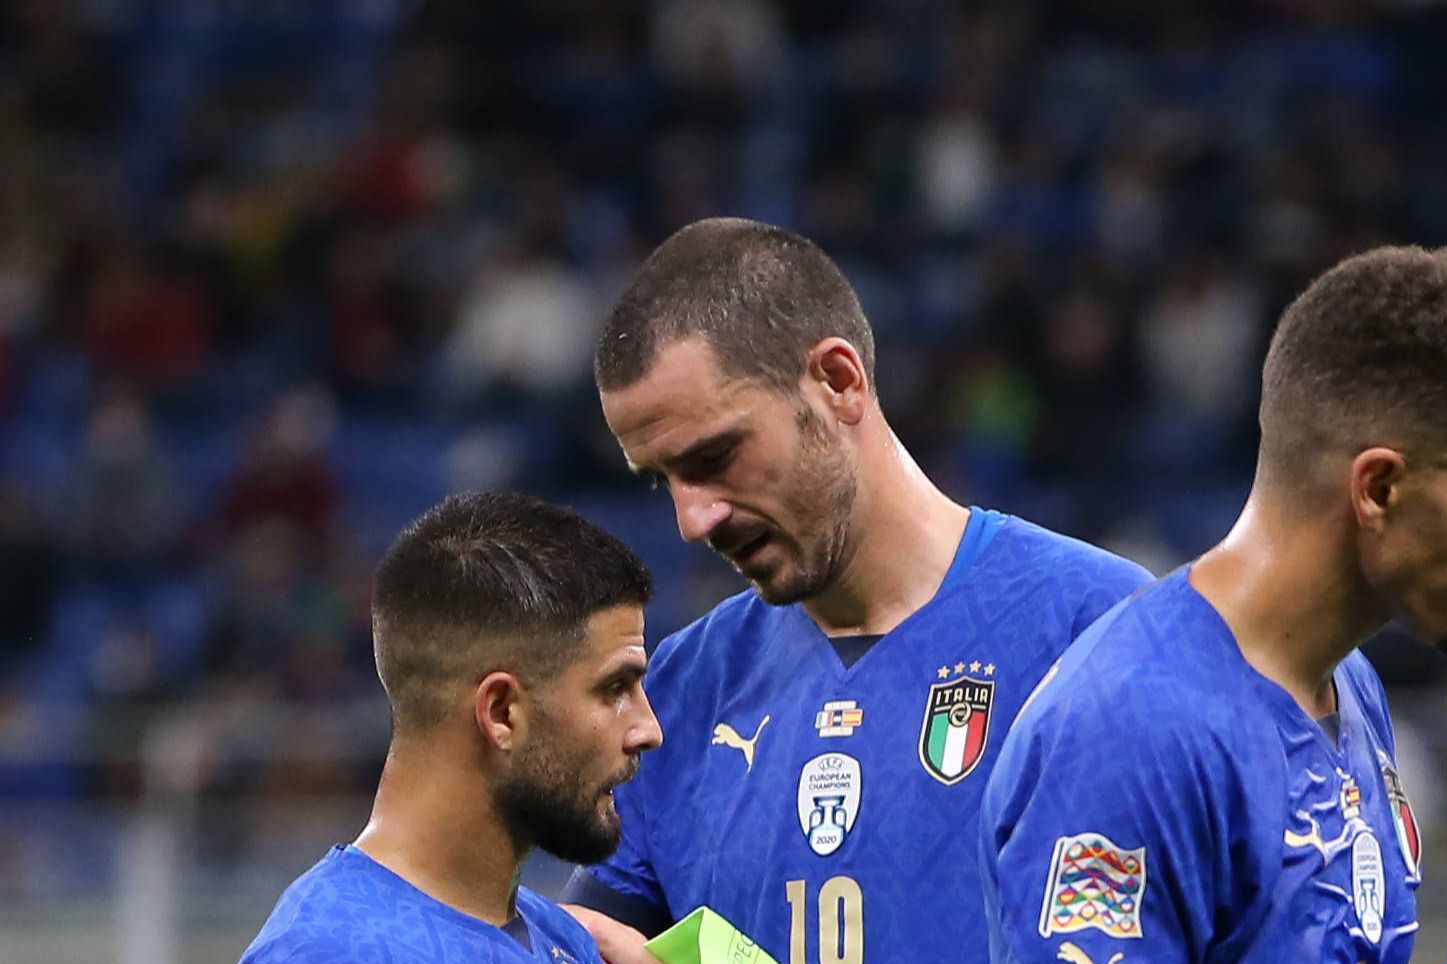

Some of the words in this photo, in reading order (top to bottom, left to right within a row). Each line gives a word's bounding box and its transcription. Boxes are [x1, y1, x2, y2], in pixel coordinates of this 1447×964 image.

[935, 687, 989, 705] ITALIA
[809, 772, 852, 782] EUROPEAN
[808, 781, 851, 791] CHAMPIONS
[816, 835, 837, 845] 2020
